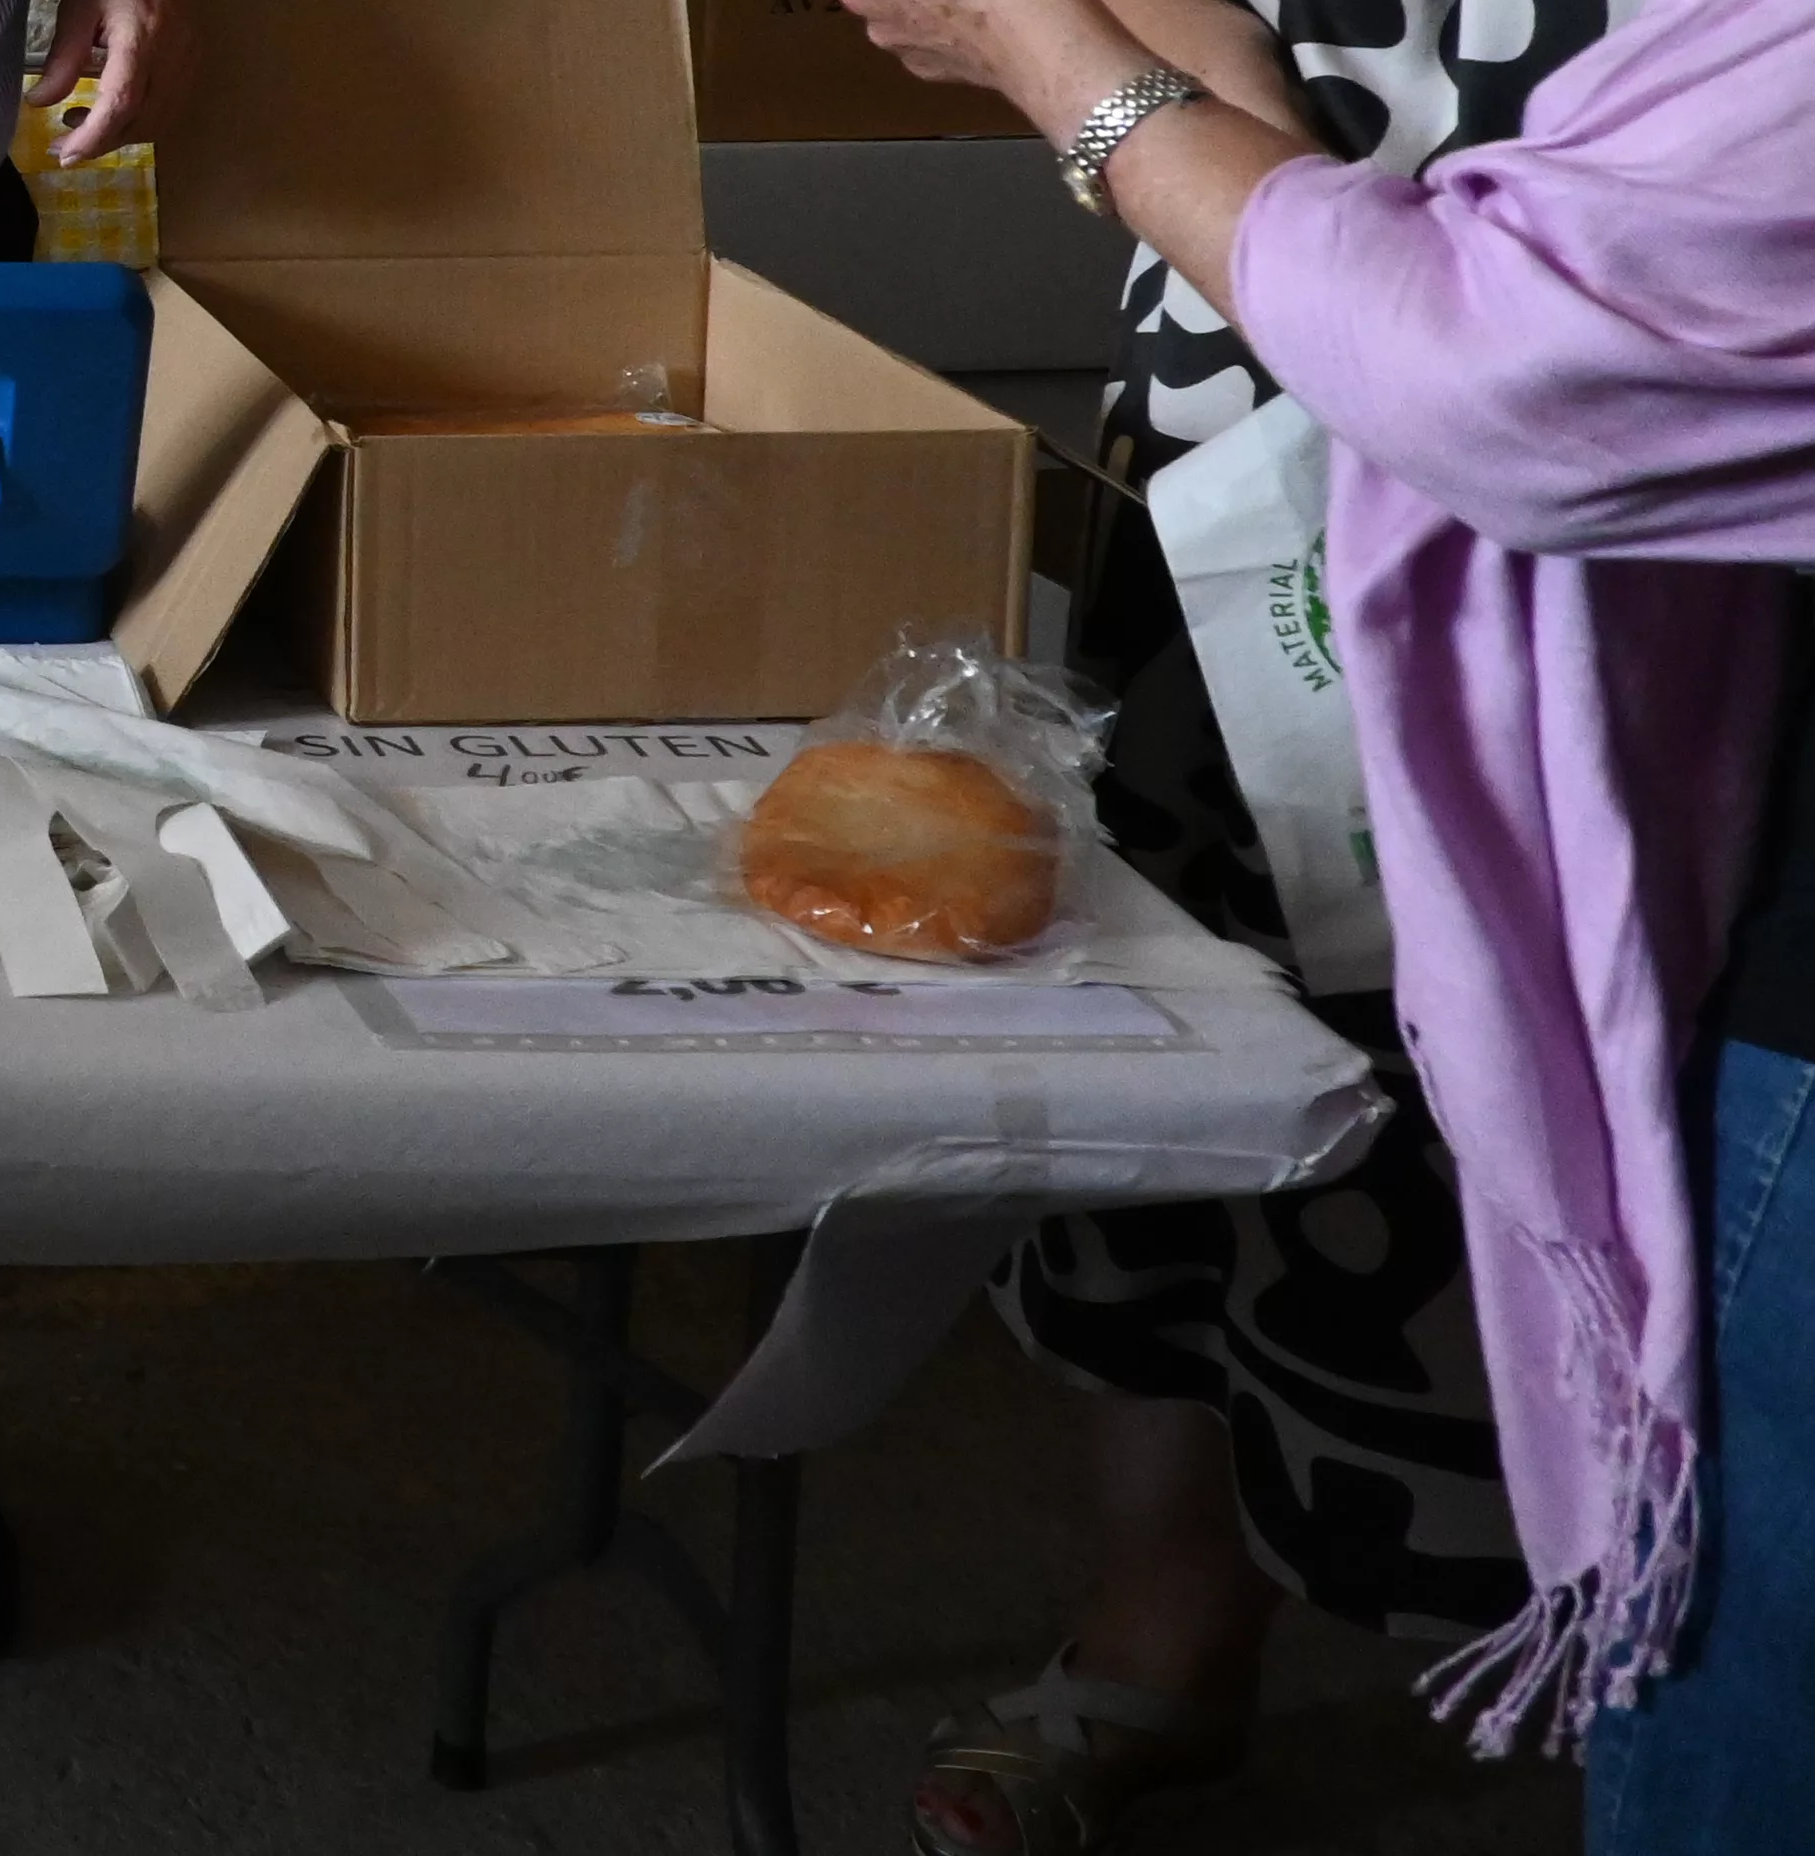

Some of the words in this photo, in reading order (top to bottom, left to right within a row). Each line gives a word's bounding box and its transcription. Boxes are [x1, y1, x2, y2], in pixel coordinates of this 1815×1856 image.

[1268, 558, 1334, 693] MATERIAL
[293, 734, 427, 758] SIN
[449, 734, 771, 759] GLUTEN
